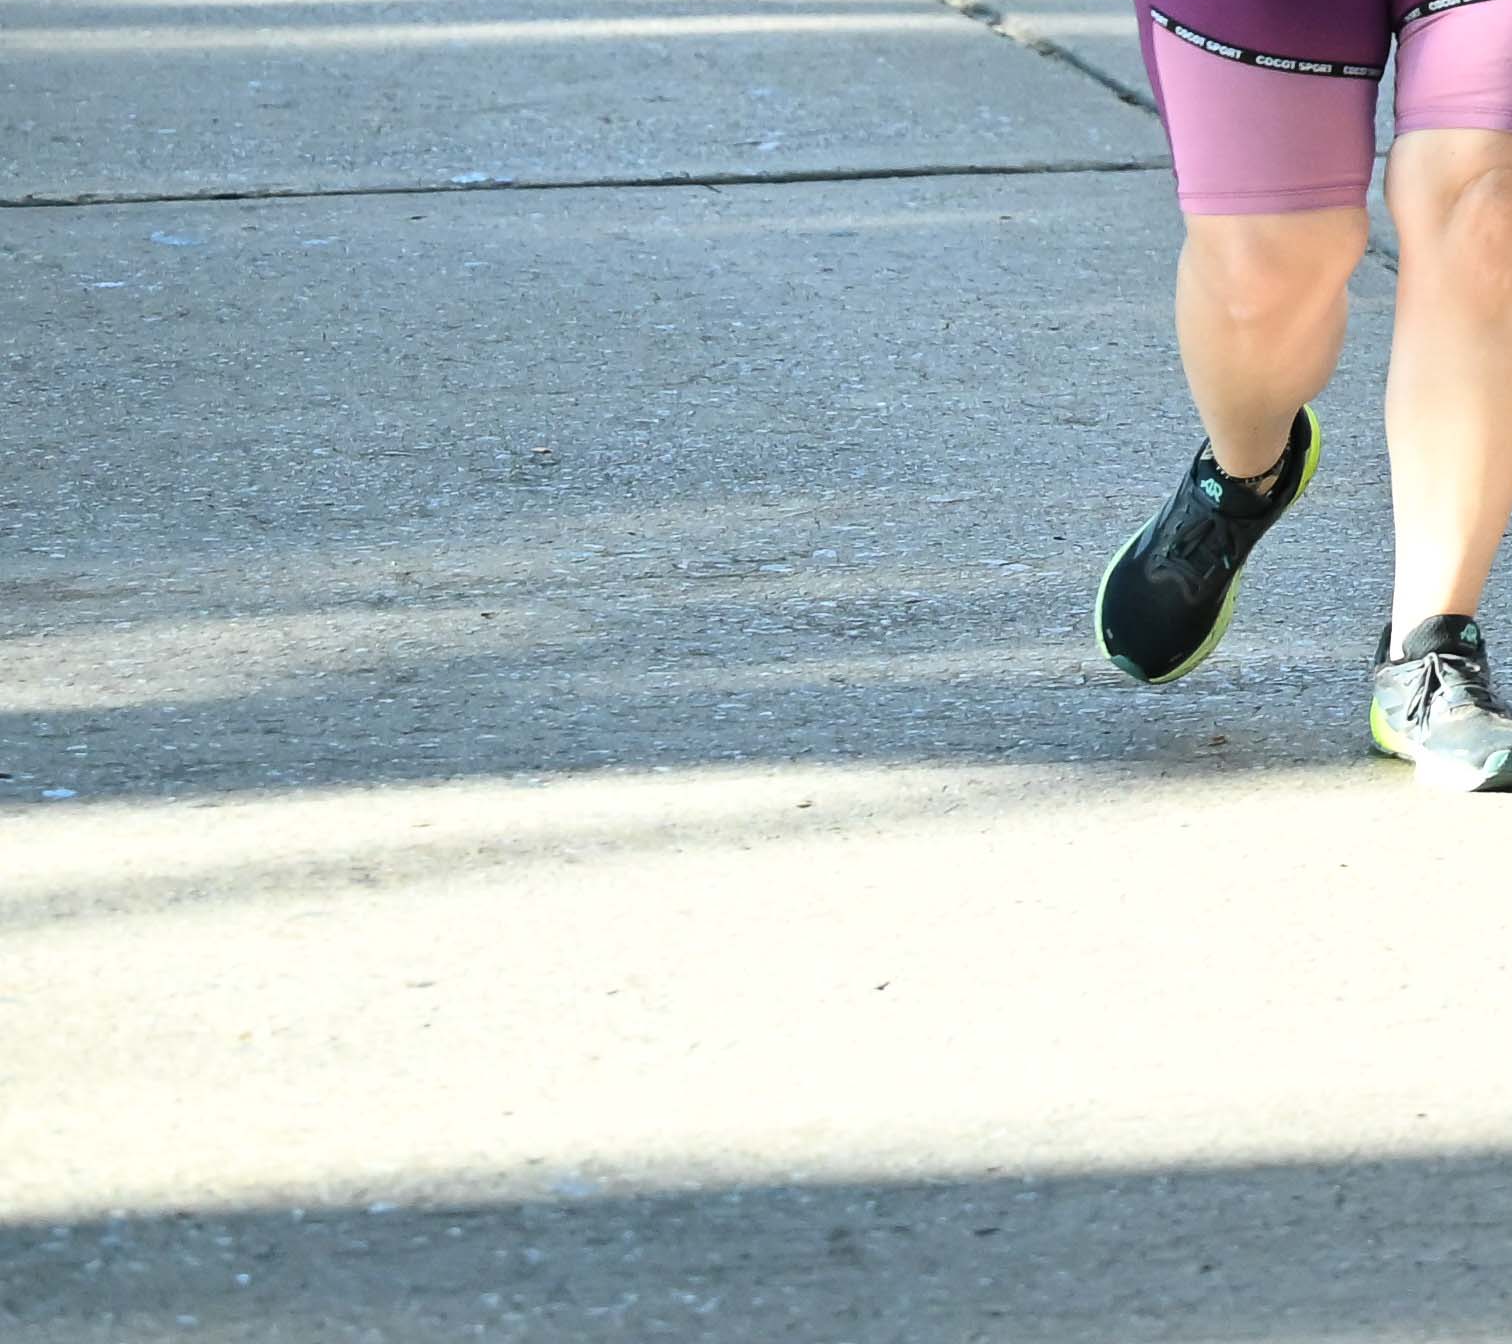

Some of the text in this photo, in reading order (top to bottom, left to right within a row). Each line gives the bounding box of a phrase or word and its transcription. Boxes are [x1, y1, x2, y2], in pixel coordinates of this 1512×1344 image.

[1206, 39, 1242, 59] SPORT
[1255, 55, 1296, 70] COCOT
[1298, 61, 1333, 74] SPORT
